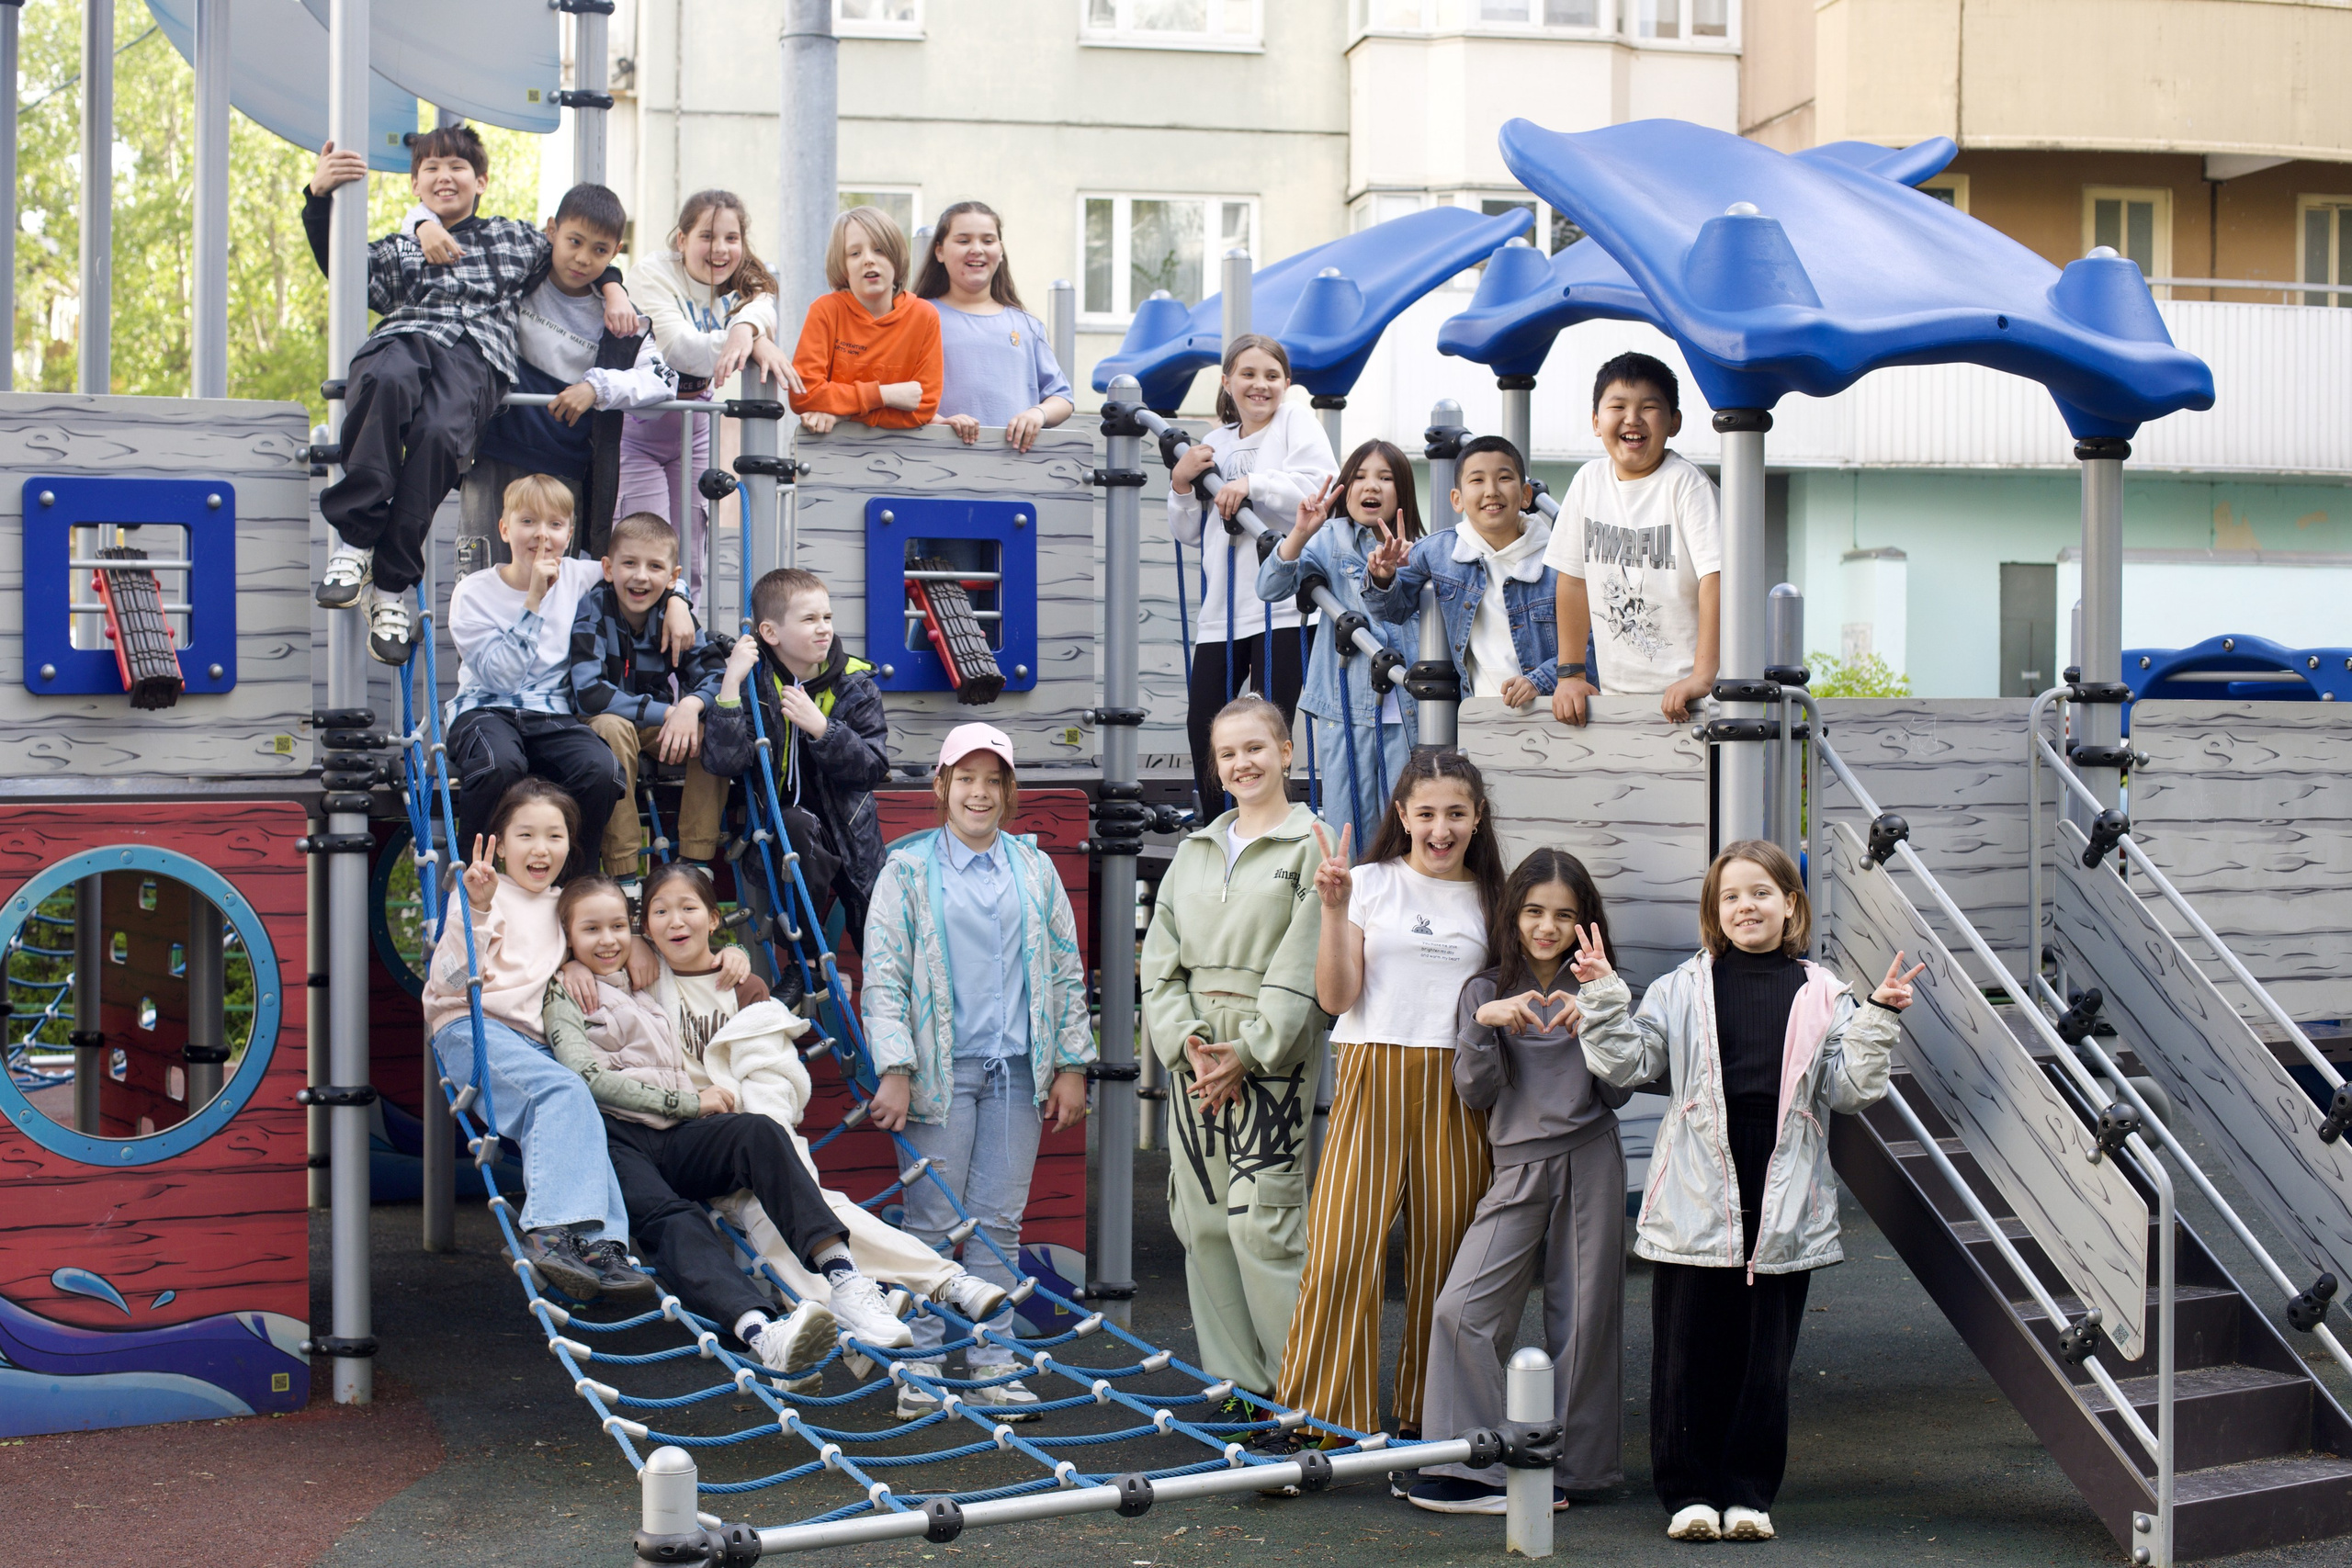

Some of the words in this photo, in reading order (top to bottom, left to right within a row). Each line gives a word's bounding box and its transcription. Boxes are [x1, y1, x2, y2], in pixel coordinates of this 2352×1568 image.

[546, 321, 567, 336] FUTURE
[570, 334, 586, 347] MAKE
[1584, 517, 1676, 570] POWERFUL
